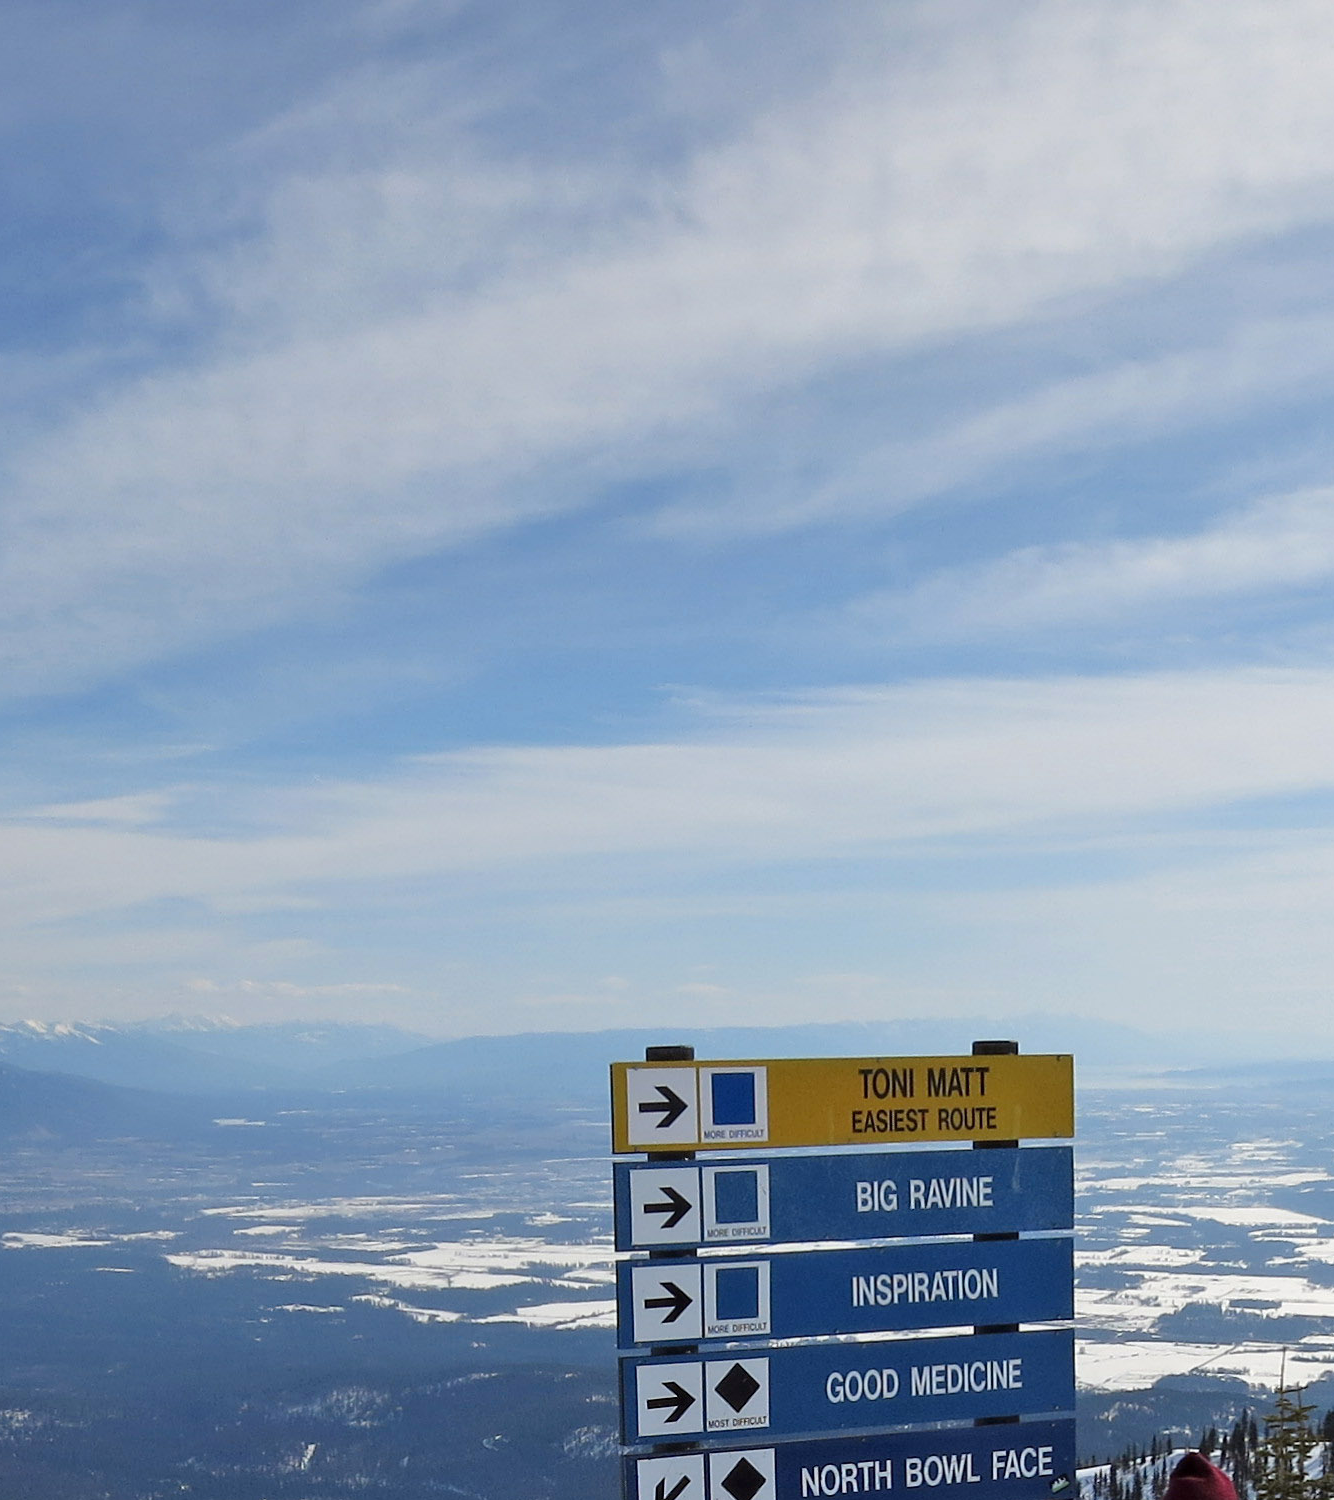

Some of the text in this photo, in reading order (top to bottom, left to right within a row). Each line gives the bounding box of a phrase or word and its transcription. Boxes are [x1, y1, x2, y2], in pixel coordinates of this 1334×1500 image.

[858, 1066, 989, 1099] TONI MATT
[703, 1129, 765, 1139] MORE DIFFICULT
[852, 1106, 997, 1133] EASIEST ROUTE
[856, 1175, 994, 1212] BIG RAVINE
[707, 1226, 767, 1238] MORE DIFFICULT
[852, 1267, 998, 1307] INSPIRATION
[707, 1322, 767, 1334] MORE DIFFICULT
[826, 1358, 1023, 1404] GOOD MEDICINE
[708, 1416, 767, 1429] MOST DIFFICULT
[801, 1446, 1054, 1498] NORTH BOWL FACE
